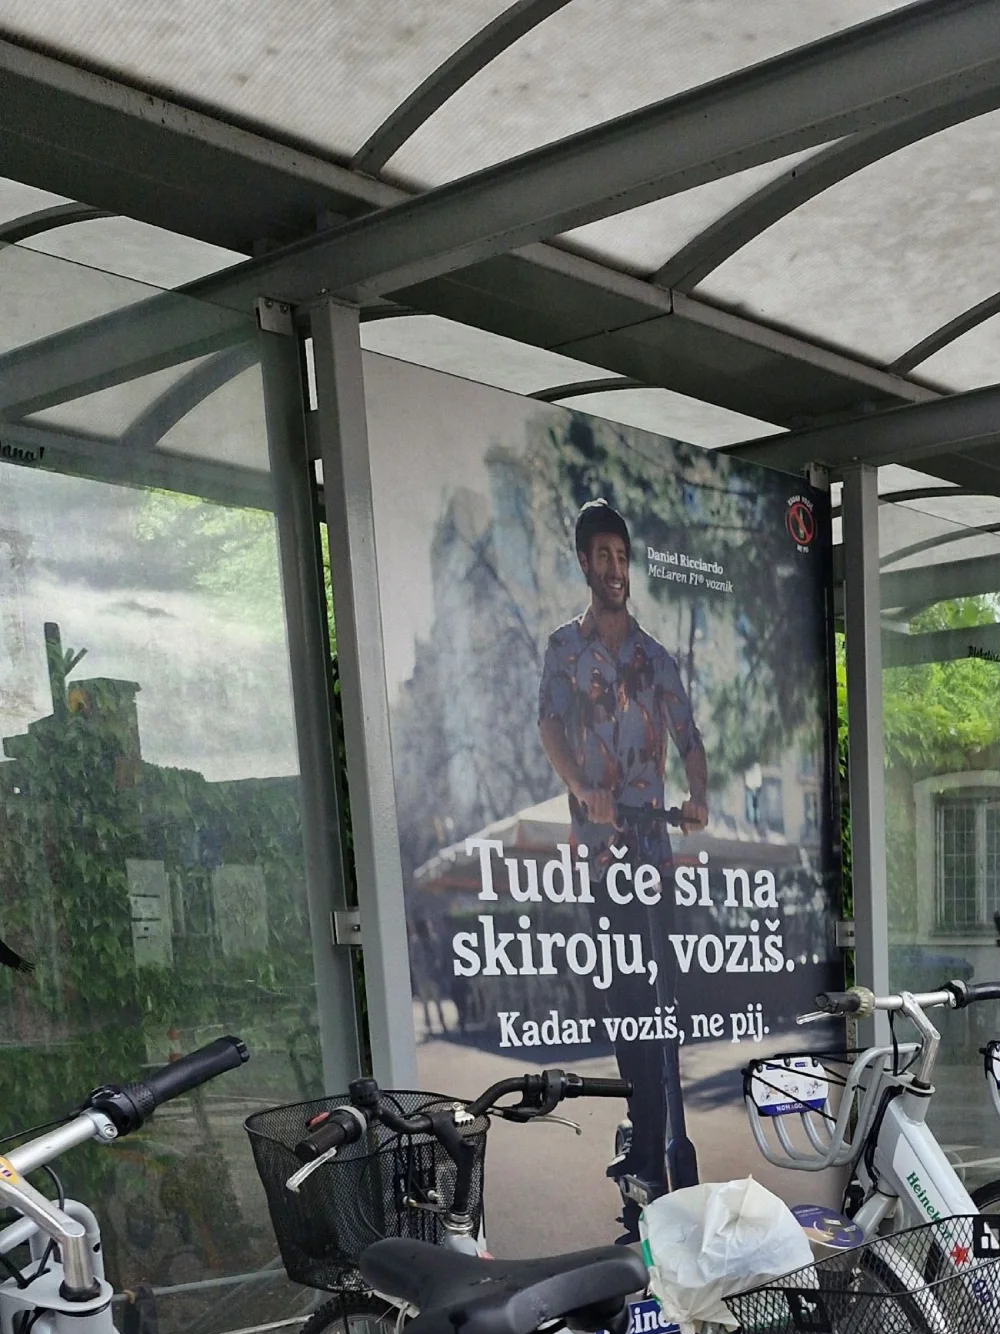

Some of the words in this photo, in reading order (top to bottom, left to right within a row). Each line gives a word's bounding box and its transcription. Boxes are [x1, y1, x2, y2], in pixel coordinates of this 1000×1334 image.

[647, 547, 678, 564] Daniel
[680, 554, 723, 575] Ricciardo
[648, 564, 687, 584] McLaren
[706, 578, 734, 593] voznik
[465, 838, 595, 904] Tudi
[606, 844, 662, 906] če
[675, 851, 714, 907] si
[723, 867, 779, 908] na
[452, 915, 658, 990] skiroju,
[498, 1010, 595, 1048] Kadar
[603, 1006, 685, 1045] voziš,
[692, 1011, 724, 1039] ne
[730, 1004, 770, 1044] pij.
